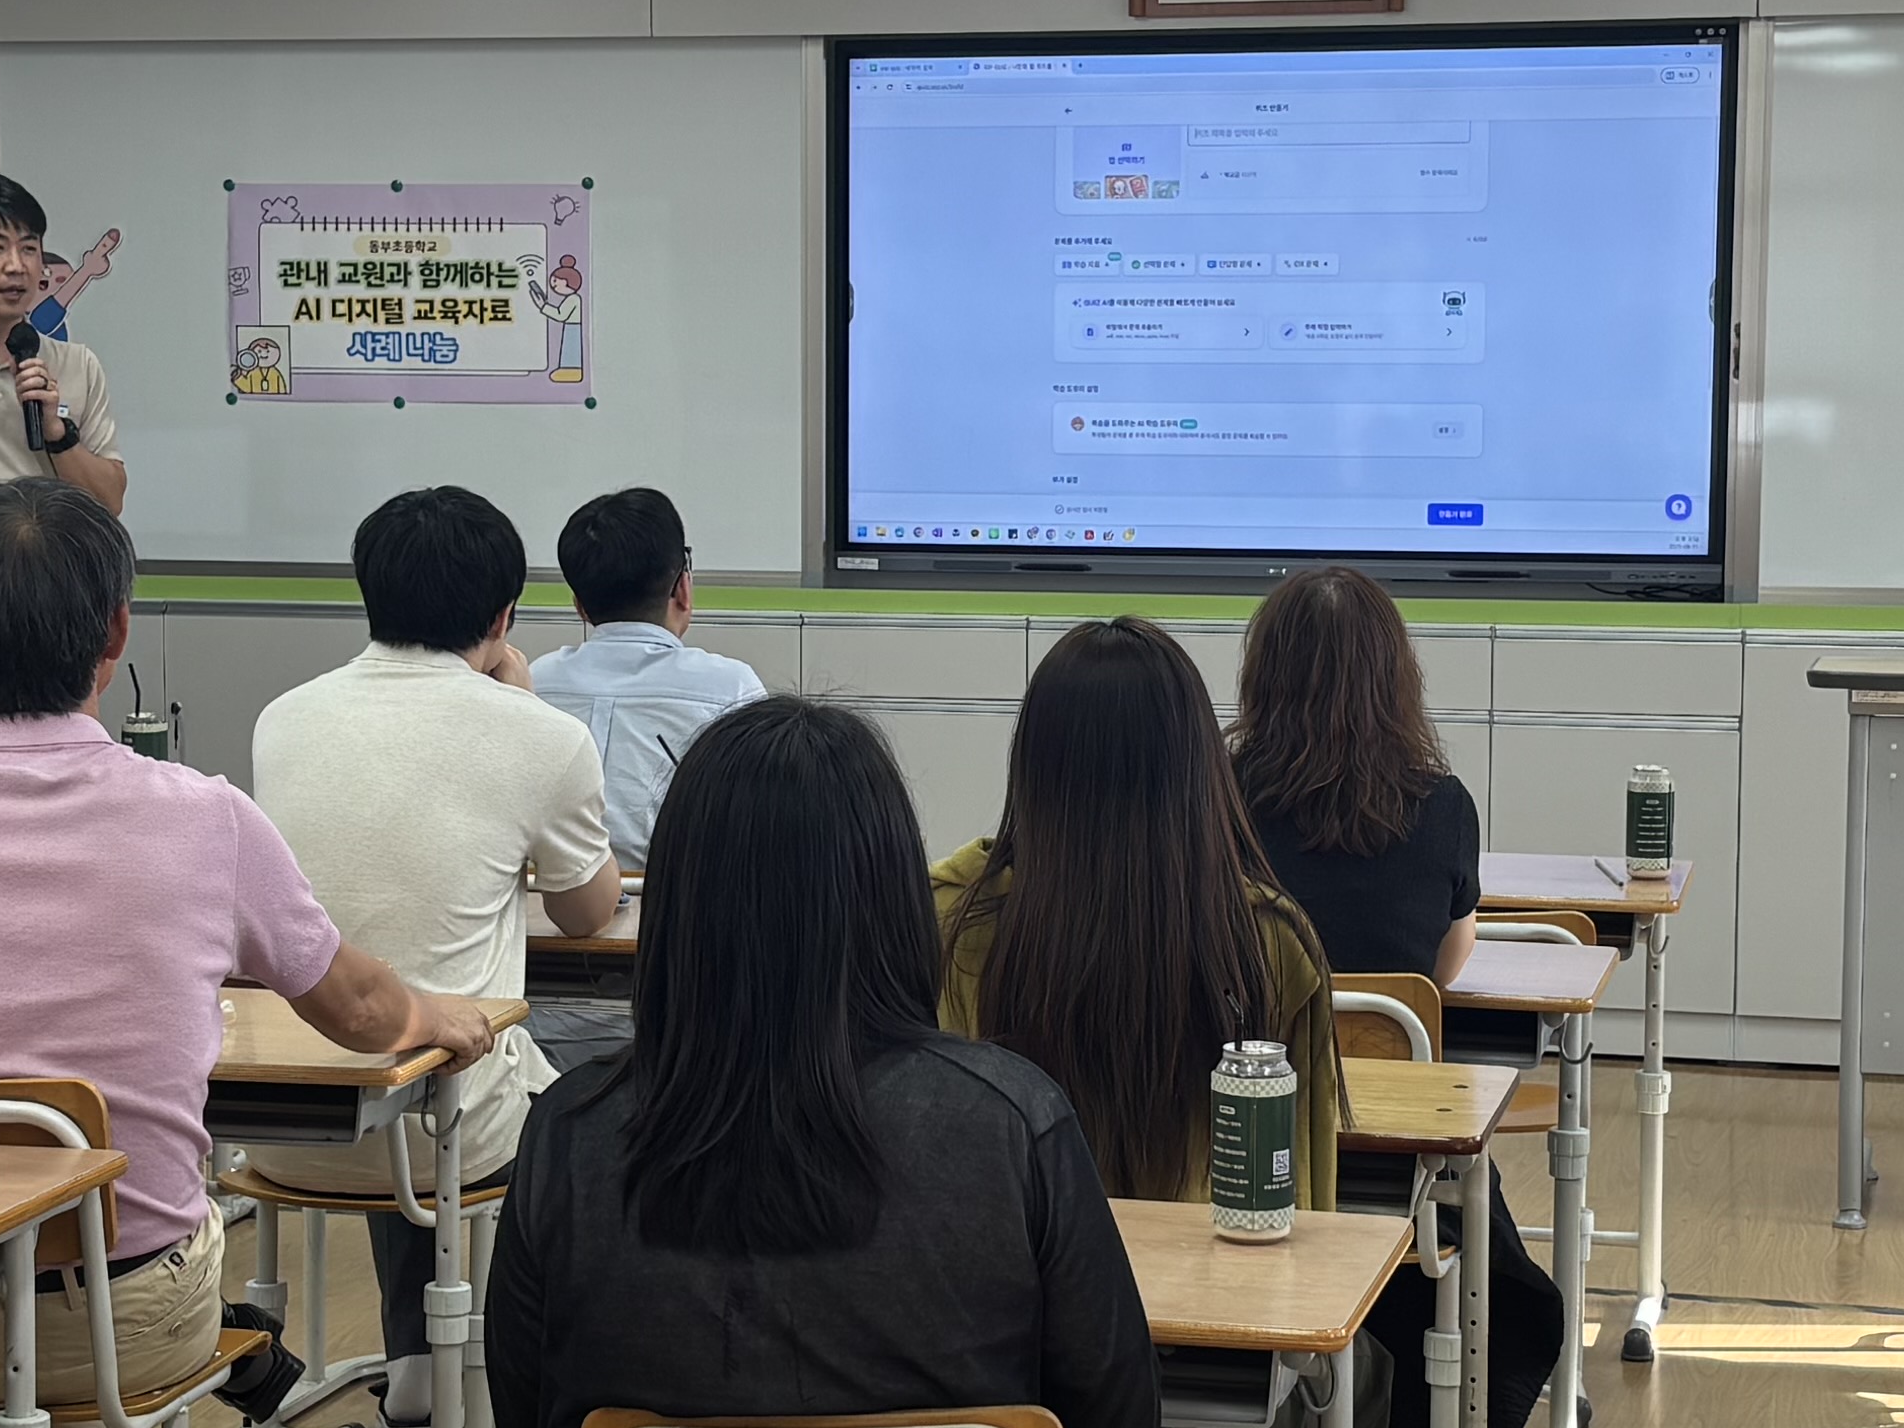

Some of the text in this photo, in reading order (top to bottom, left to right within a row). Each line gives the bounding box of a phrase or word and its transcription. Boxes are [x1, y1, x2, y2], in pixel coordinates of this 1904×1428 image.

[278, 259, 519, 289] 관내 교원과 함께하는
[295, 297, 512, 324] AI 디지털 교육자료
[347, 331, 459, 364] 사례 나눔
